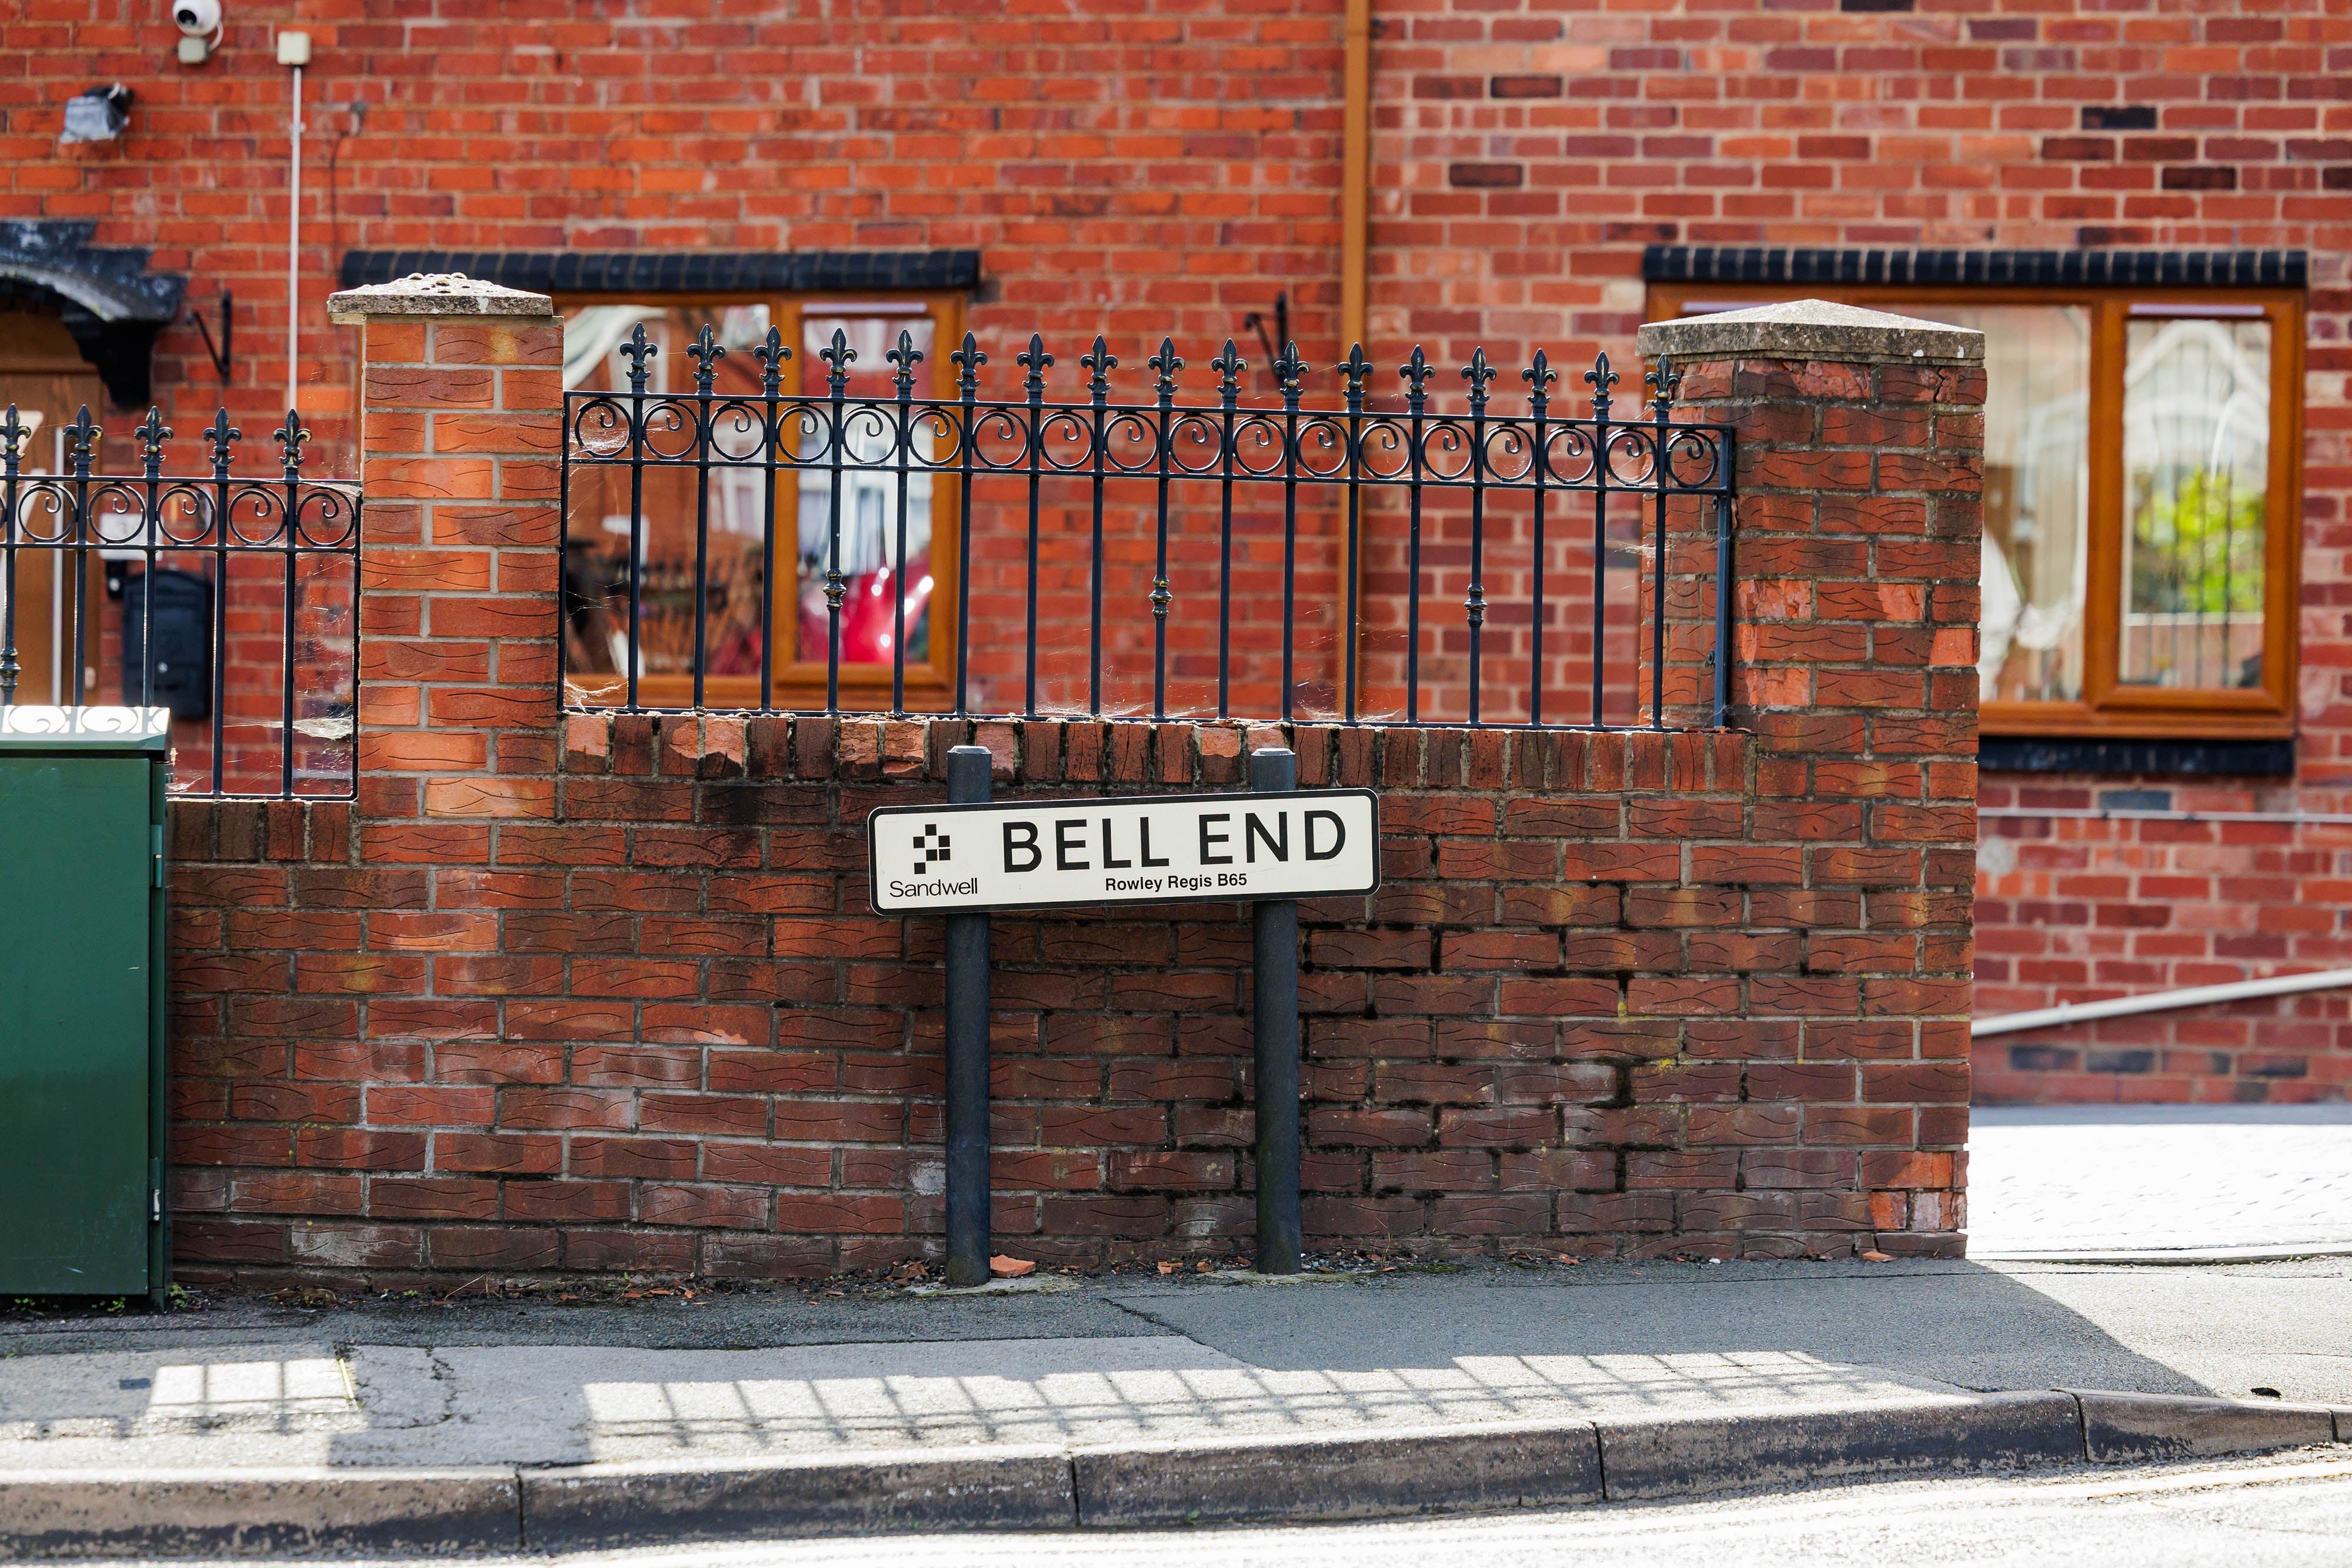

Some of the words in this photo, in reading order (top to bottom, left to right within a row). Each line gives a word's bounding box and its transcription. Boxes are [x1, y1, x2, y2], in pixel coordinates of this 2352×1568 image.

[1003, 817, 1170, 873] BELL
[1198, 810, 1346, 865] END
[889, 877, 978, 898] Sandwell
[1105, 877, 1162, 892] Rowley
[1168, 875, 1212, 891] Regis
[1218, 873, 1248, 887] B65
